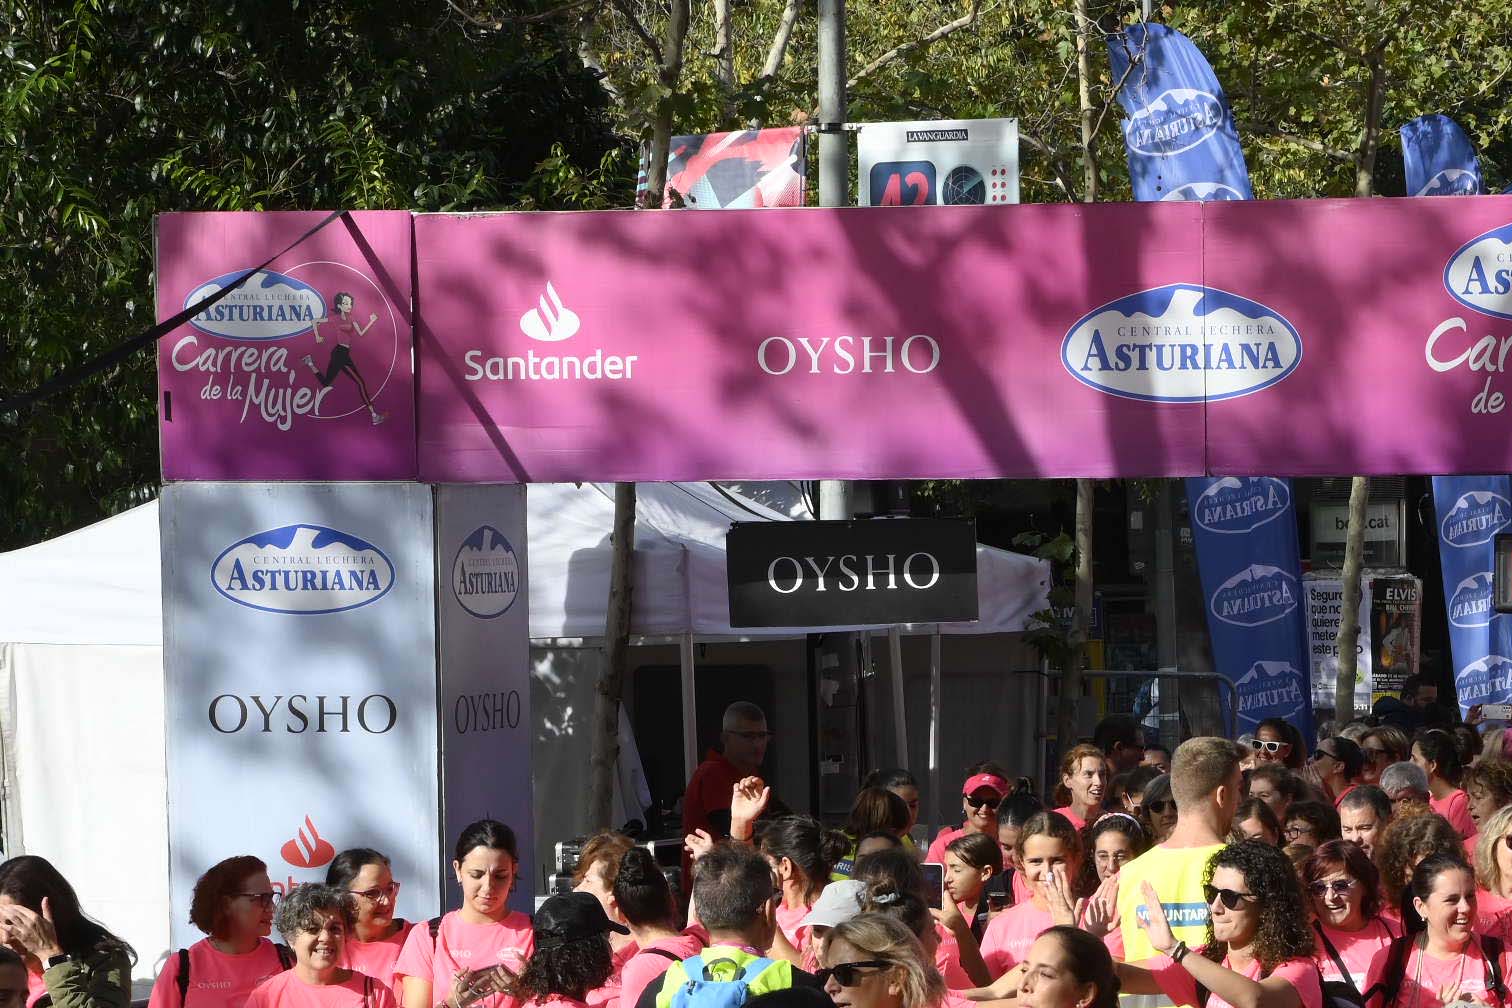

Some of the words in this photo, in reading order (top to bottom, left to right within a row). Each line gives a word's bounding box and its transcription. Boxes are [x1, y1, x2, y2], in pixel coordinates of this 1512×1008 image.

[908, 131, 918, 141] LA
[918, 129, 967, 140] VANGUARDIA
[199, 300, 316, 323] ASTURIANA
[265, 291, 311, 301] LECHERA
[1117, 326, 1192, 337] CENTRAL
[1200, 324, 1276, 336] LECHERA
[171, 336, 290, 372] Carrera
[464, 350, 638, 380] Santander
[757, 334, 940, 375] OYSHO
[1080, 328, 1283, 372] ASTURIANA
[201, 375, 223, 400] de
[227, 375, 243, 400] la
[241, 369, 335, 431] Mujer
[1471, 377, 1505, 416] de
[225, 558, 381, 592] ASTURIANA
[254, 555, 308, 565] CENTRAL
[315, 554, 375, 565] LECHERA
[457, 558, 516, 595] ASTURIANA
[767, 552, 940, 594] OYSHO
[1312, 605, 1327, 616] que
[1386, 588, 1417, 600] ELVIS
[1313, 644, 1332, 654] este
[208, 694, 397, 734] OYSHO
[455, 690, 520, 734] OYSHO
